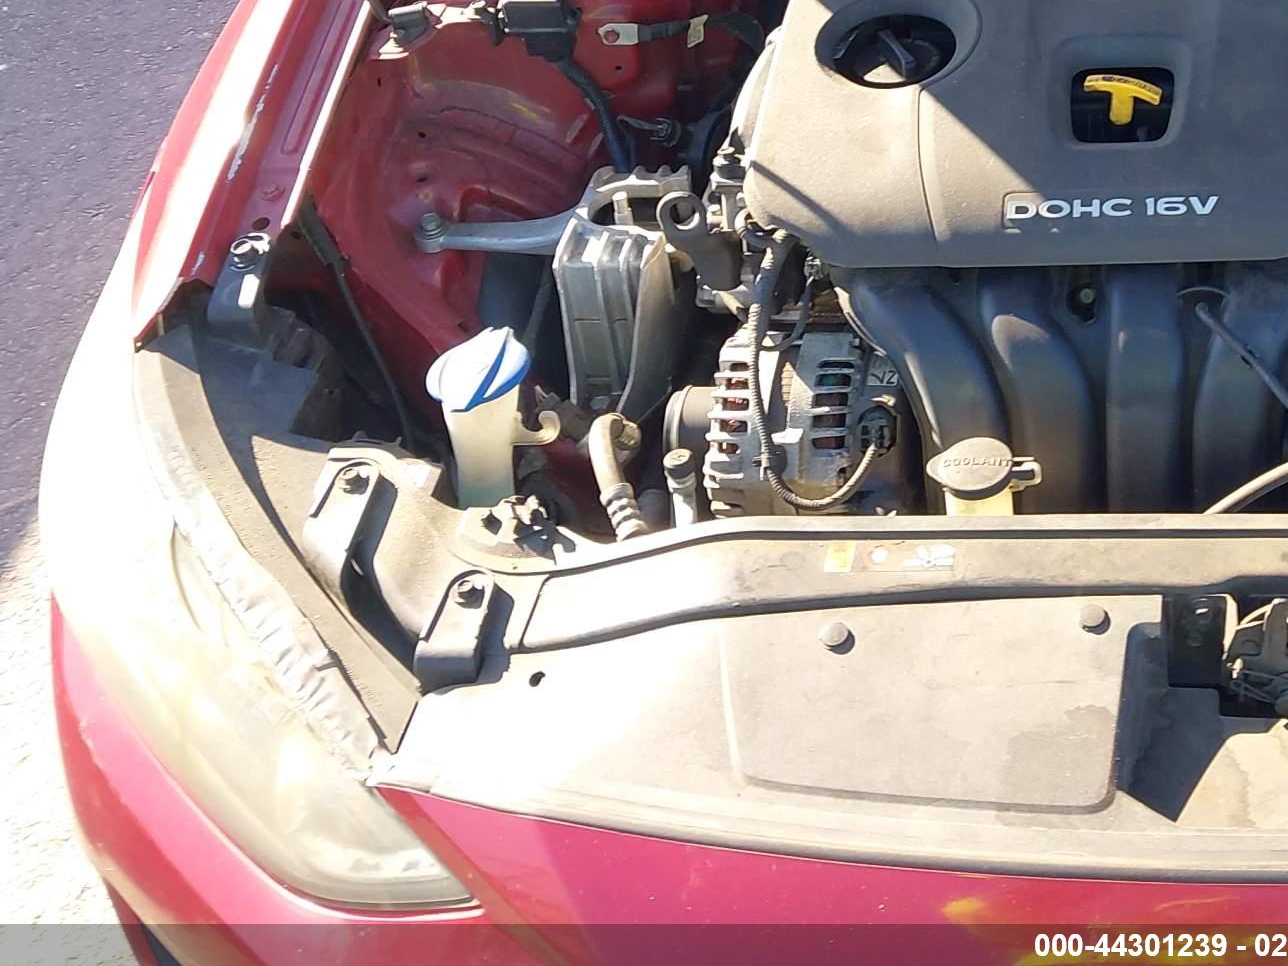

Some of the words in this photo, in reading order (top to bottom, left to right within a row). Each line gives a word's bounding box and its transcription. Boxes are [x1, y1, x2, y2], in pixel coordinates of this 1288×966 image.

[1006, 198, 1132, 219] DOHC
[1145, 196, 1219, 216] 16V
[942, 456, 1013, 468] COOLANT
